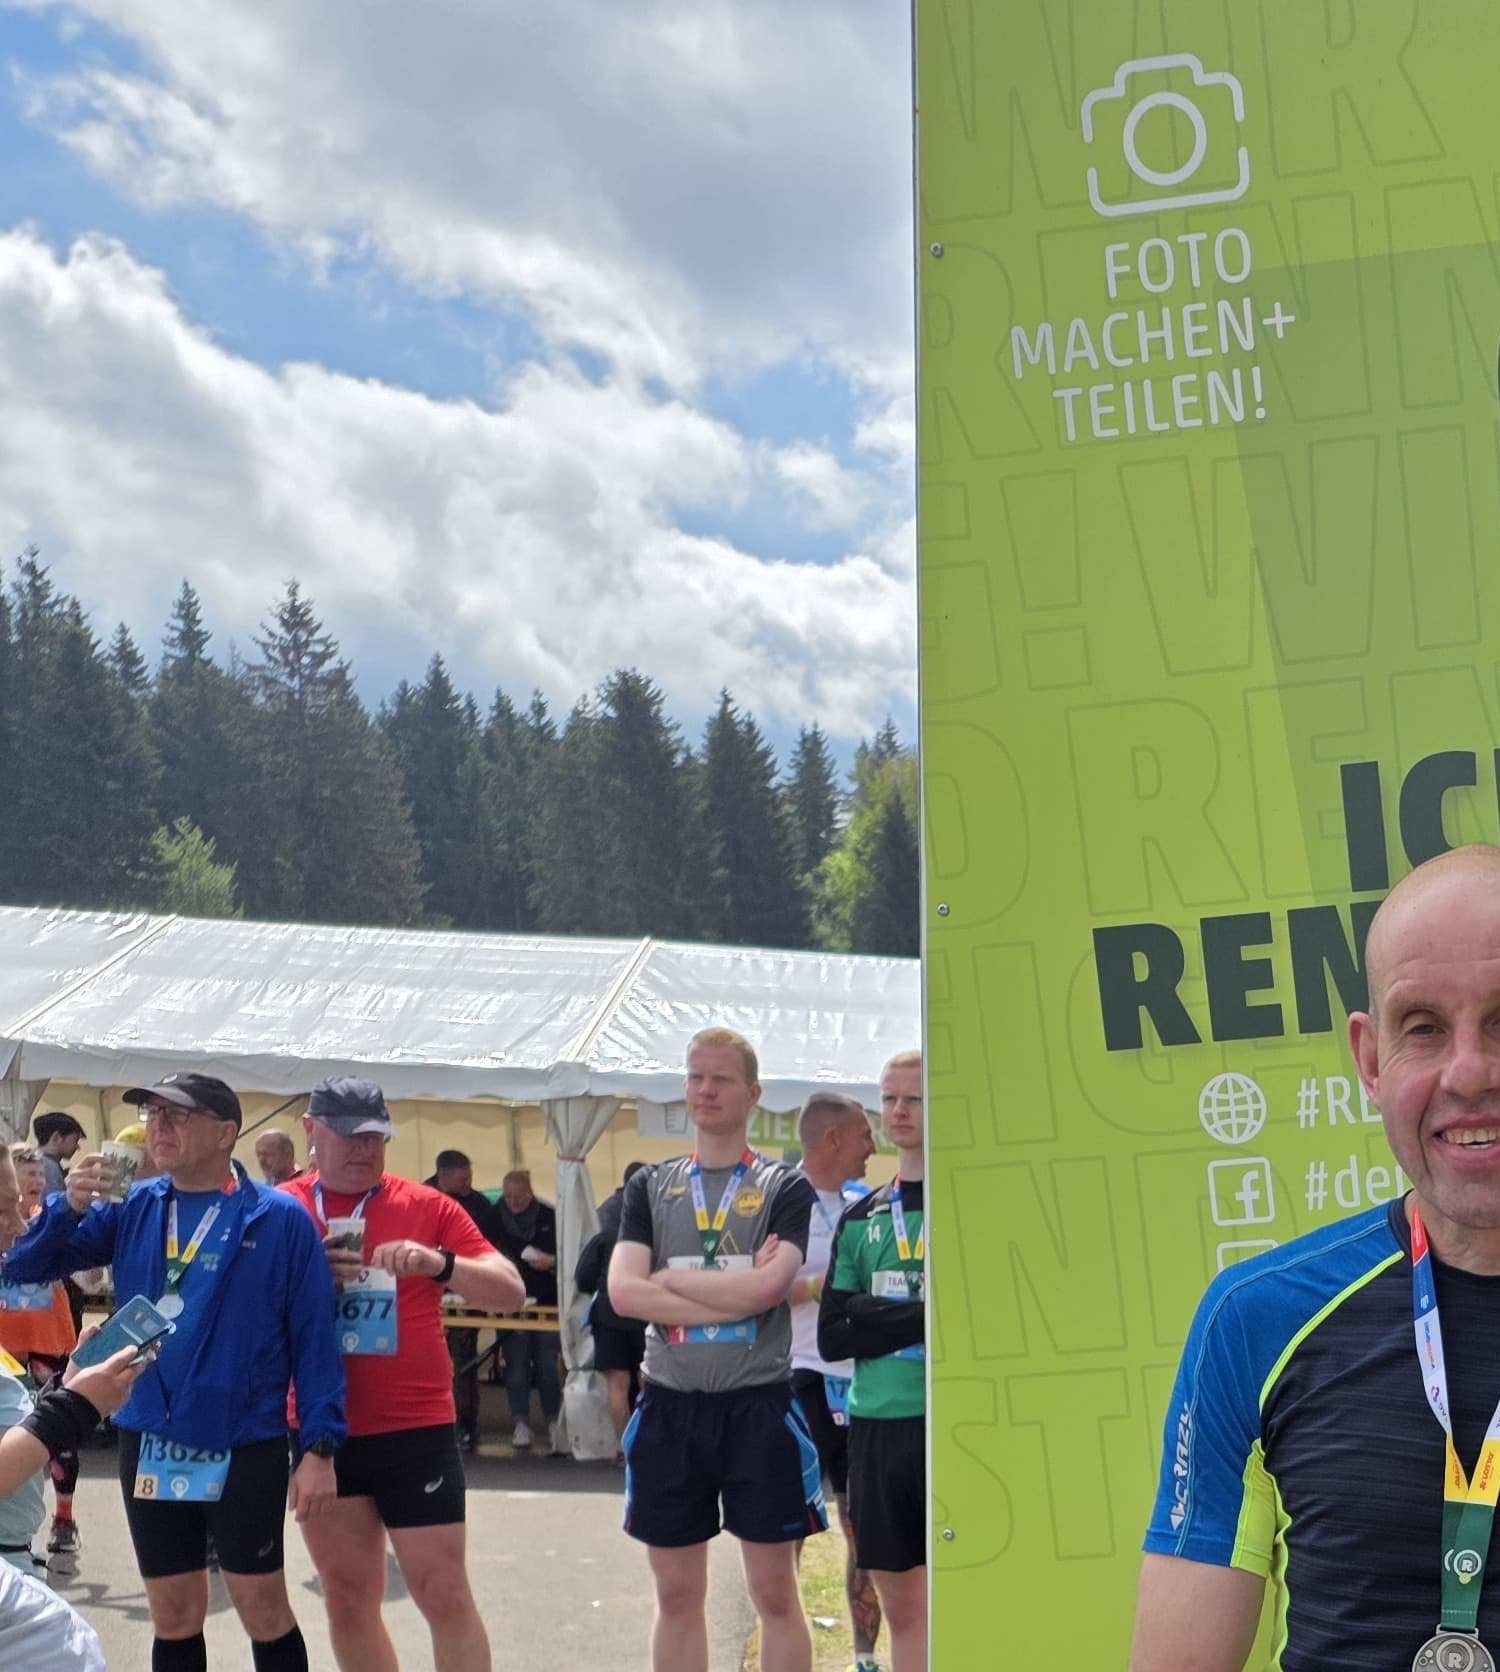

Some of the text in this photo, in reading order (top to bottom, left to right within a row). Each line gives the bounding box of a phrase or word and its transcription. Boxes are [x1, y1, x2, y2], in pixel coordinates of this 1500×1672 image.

[1104, 227, 1252, 299] FOTO
[1010, 296, 1296, 380] MACHEN+
[1052, 366, 1267, 442] TEILEN!
[333, 1298, 394, 1322] 677
[142, 1477, 155, 1497] 8
